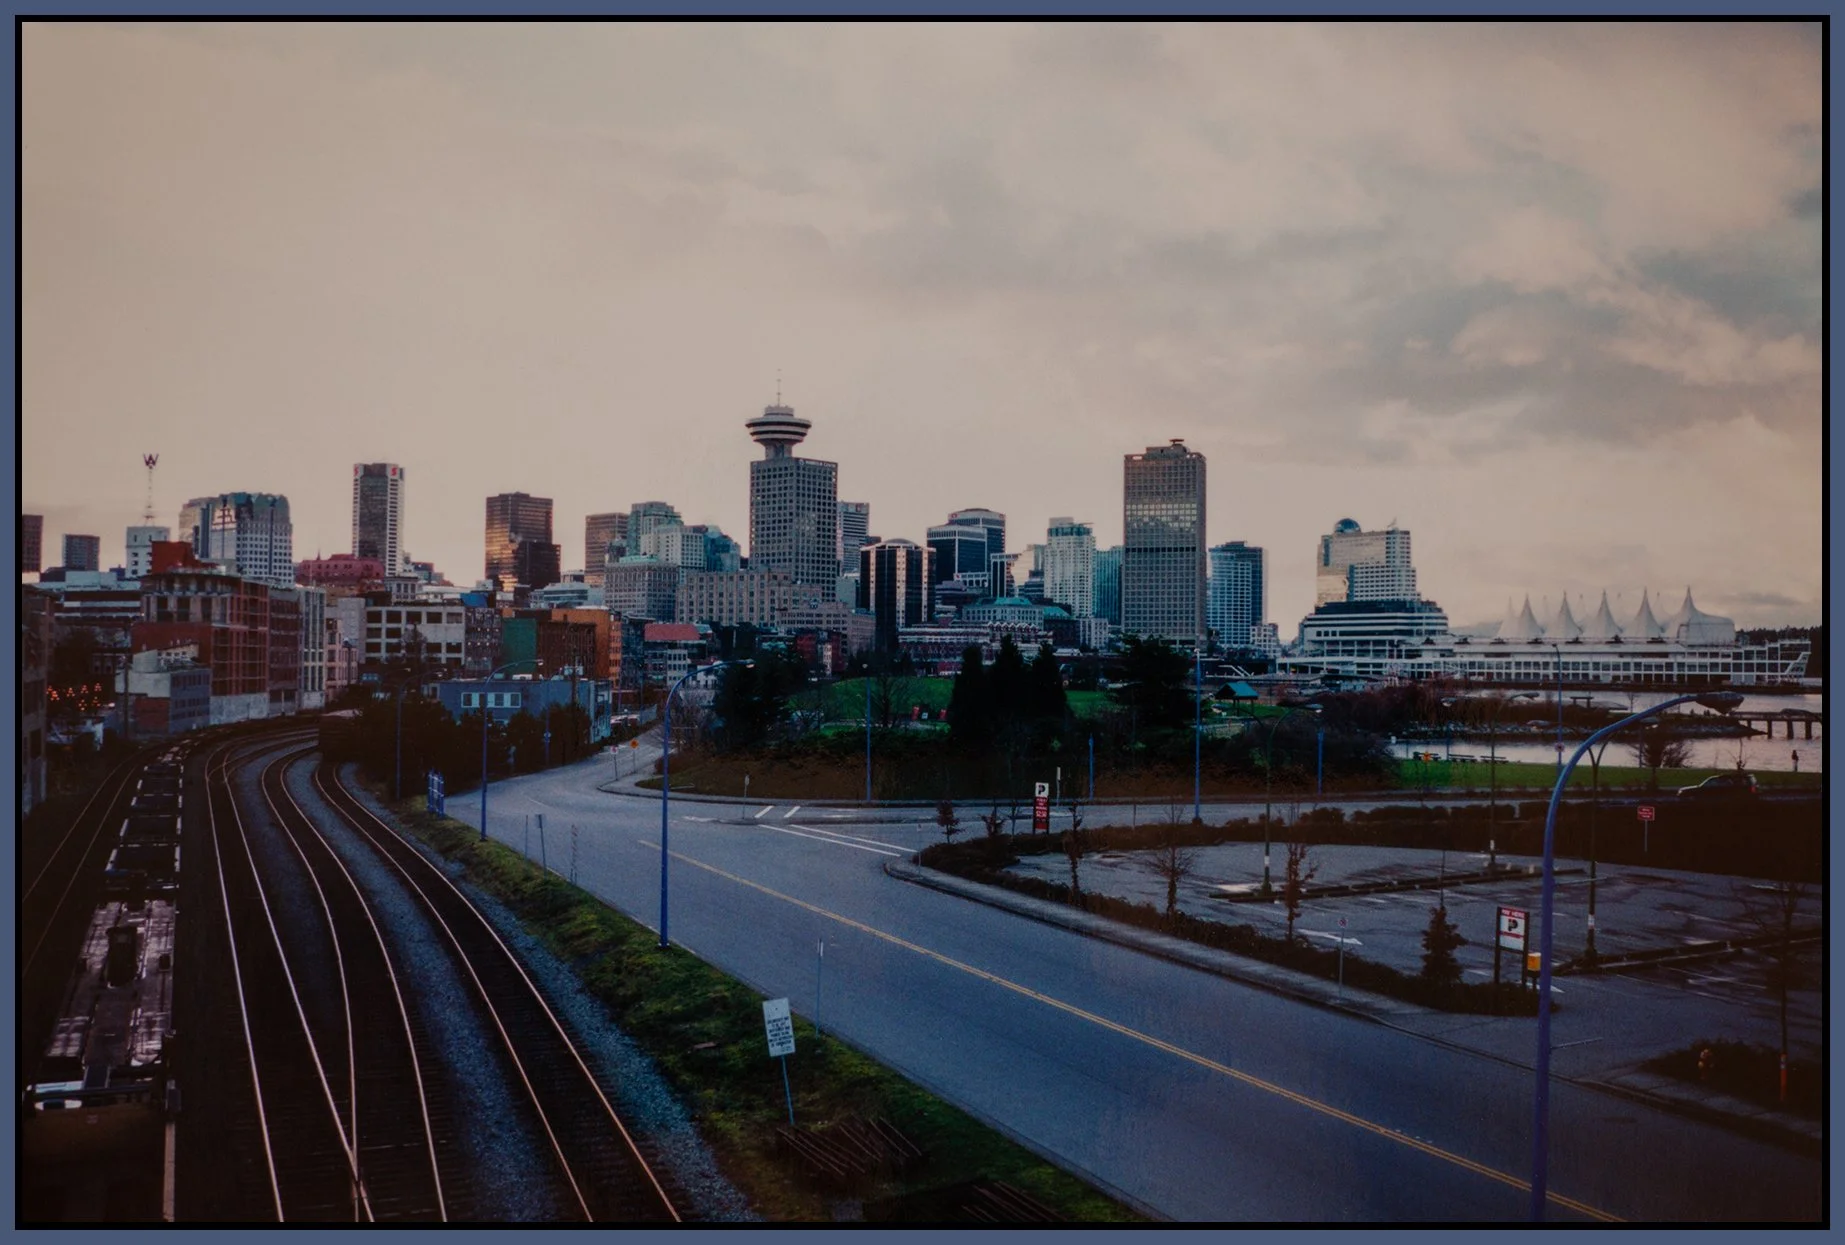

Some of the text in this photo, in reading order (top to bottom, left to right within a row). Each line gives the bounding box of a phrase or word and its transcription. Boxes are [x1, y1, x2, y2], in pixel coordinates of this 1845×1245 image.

[143, 453, 159, 466] W
[1038, 784, 1046, 795] P
[1508, 918, 1518, 931] P
